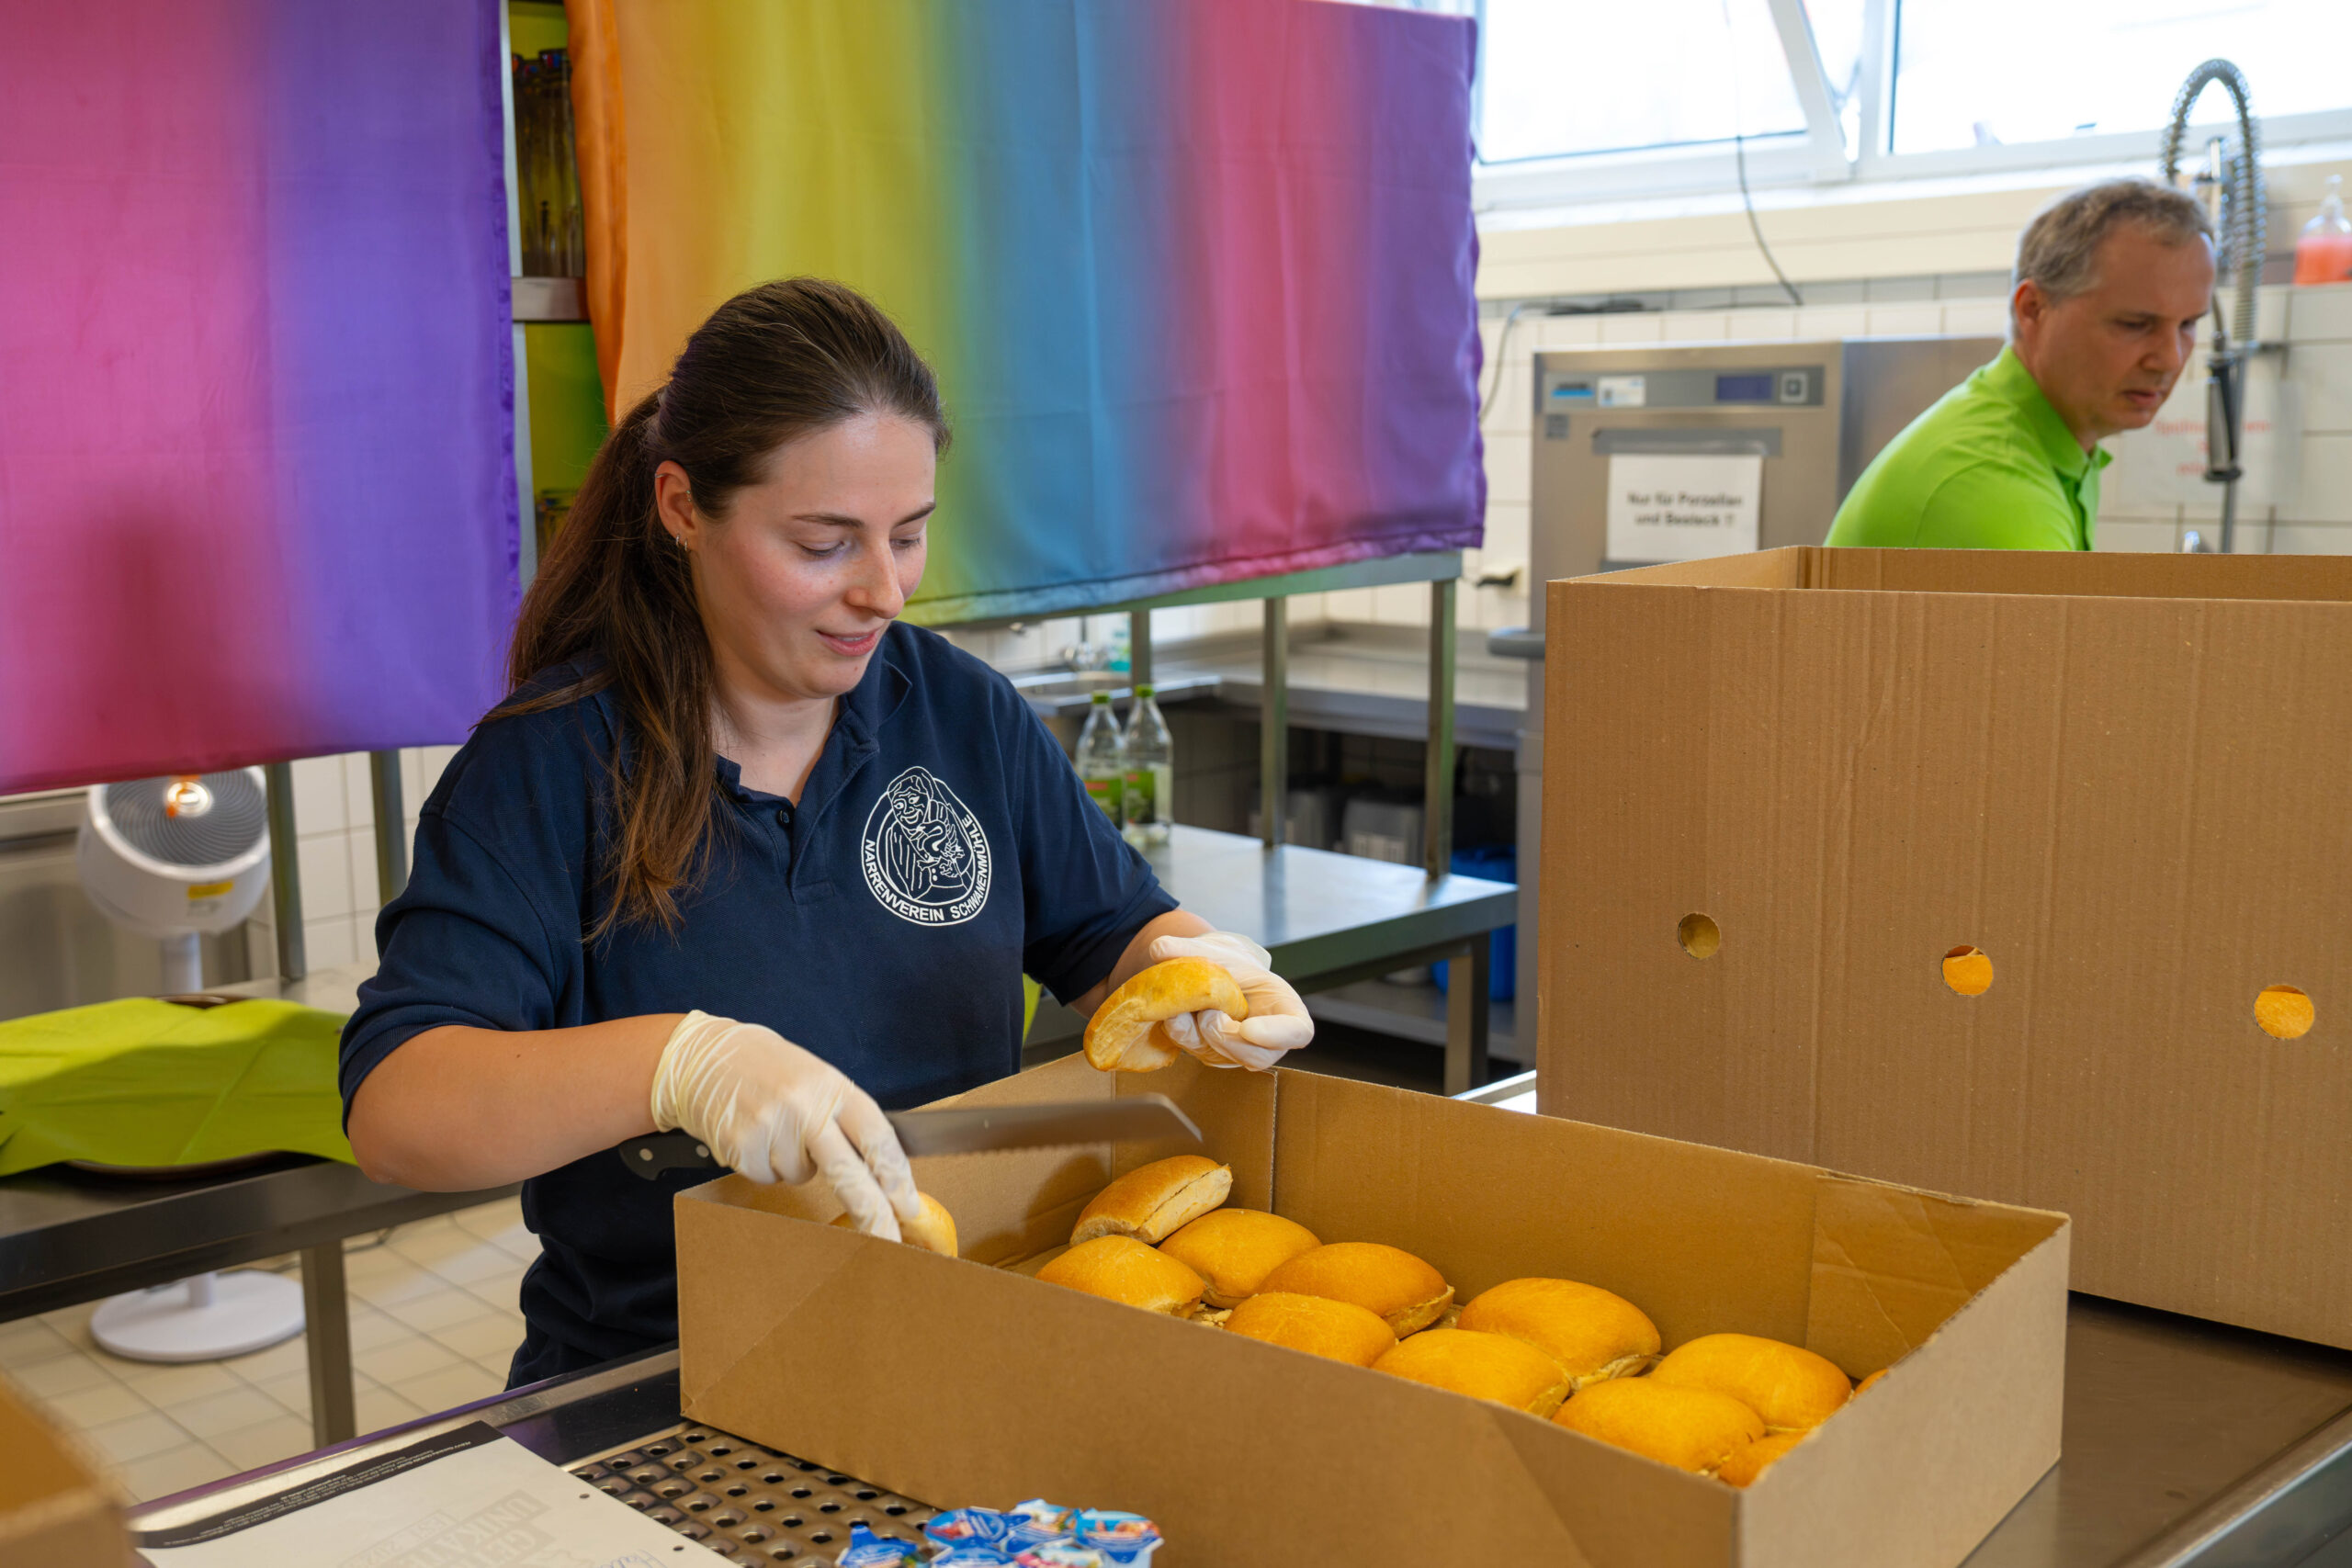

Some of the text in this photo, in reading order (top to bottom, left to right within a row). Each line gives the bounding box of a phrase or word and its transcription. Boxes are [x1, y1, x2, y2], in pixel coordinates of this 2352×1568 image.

[1678, 491, 1743, 505] Porzellan
[864, 814, 988, 921] NARRENVEREIN SCHWANENMÜHLE
